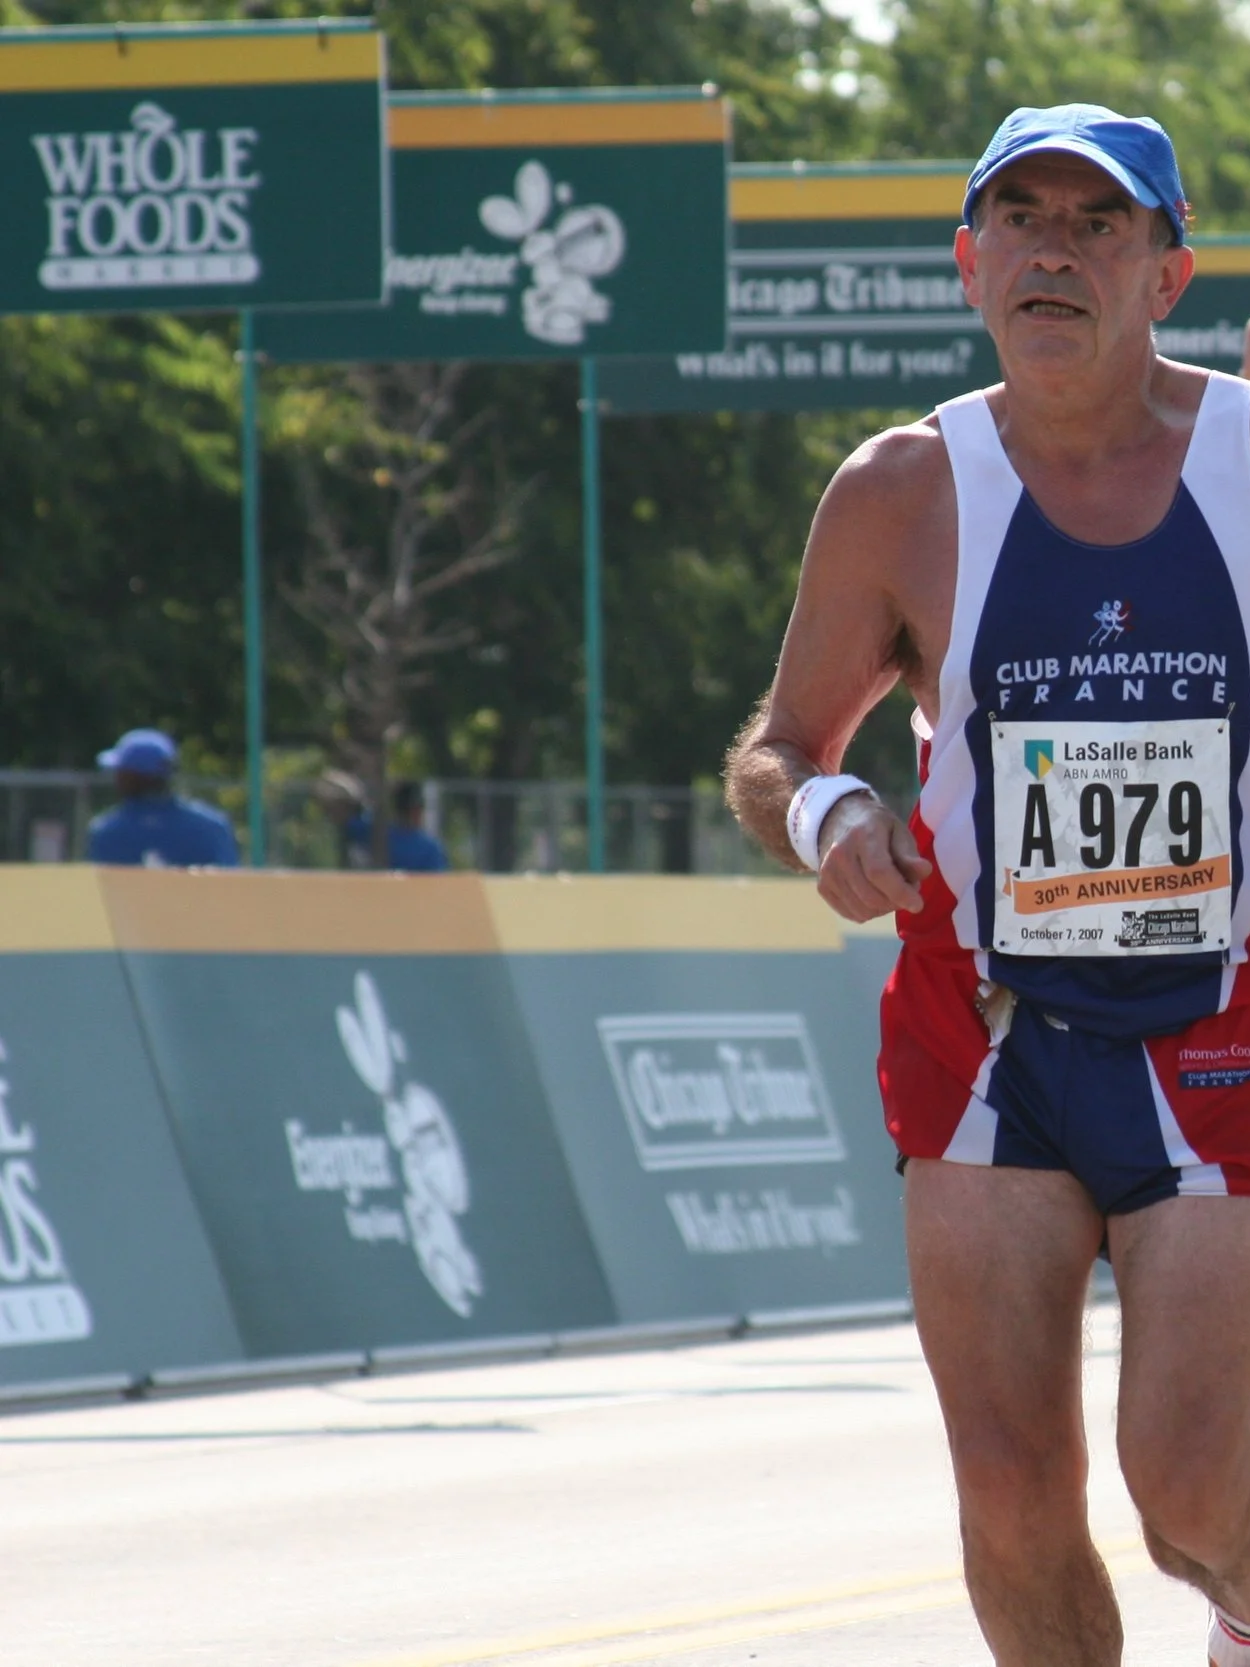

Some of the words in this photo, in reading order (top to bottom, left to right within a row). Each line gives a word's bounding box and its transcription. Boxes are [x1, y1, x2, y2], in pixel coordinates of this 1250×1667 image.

[30, 126, 261, 195] WHOLE
[46, 191, 250, 256] FOODS
[388, 247, 518, 293] nergizer
[996, 657, 1060, 684] CLUB
[1069, 652, 1226, 676] MARATHON
[1064, 741, 1137, 761] LaSalle
[1144, 740, 1193, 760] Bank
[1063, 768, 1088, 780] ABN
[1093, 768, 1128, 780] AMRO
[1020, 783, 1056, 868] A
[1079, 781, 1203, 869] 979
[1034, 884, 1070, 906] 30th
[1077, 867, 1215, 900] ANNIVERSARY
[1021, 927, 1063, 941] October
[1067, 928, 1076, 942] 7,
[1079, 927, 1103, 941] 2007
